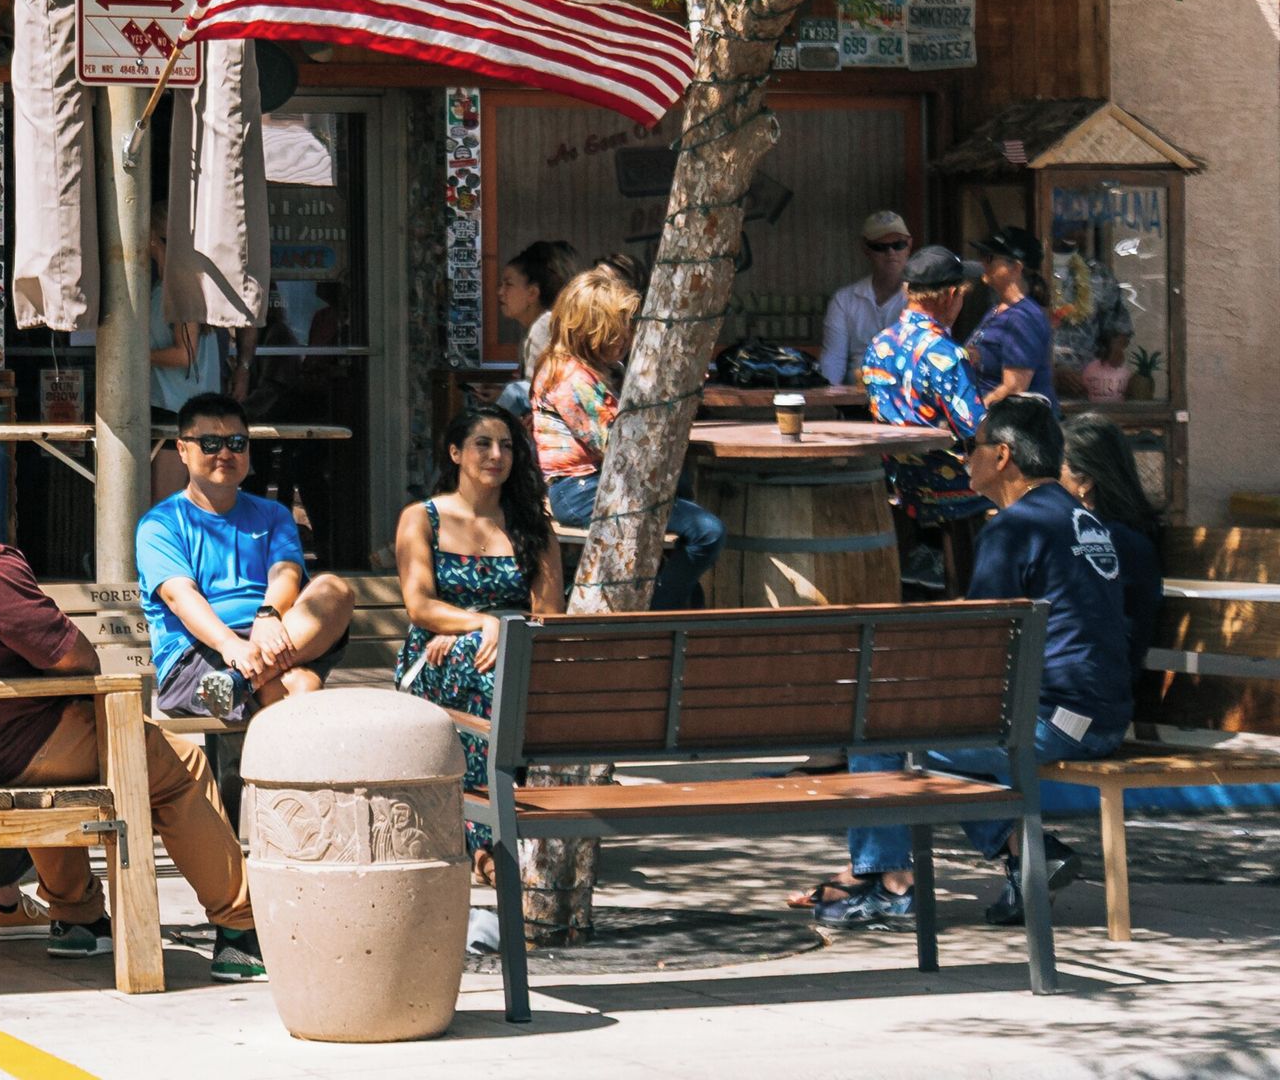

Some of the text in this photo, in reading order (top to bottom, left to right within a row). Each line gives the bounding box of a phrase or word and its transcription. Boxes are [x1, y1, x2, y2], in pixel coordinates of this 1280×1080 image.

[131, 34, 143, 44] YES
[157, 37, 167, 46] NO
[85, 64, 96, 74] PER
[102, 65, 113, 74] NRS
[99, 623, 132, 635] Alan
